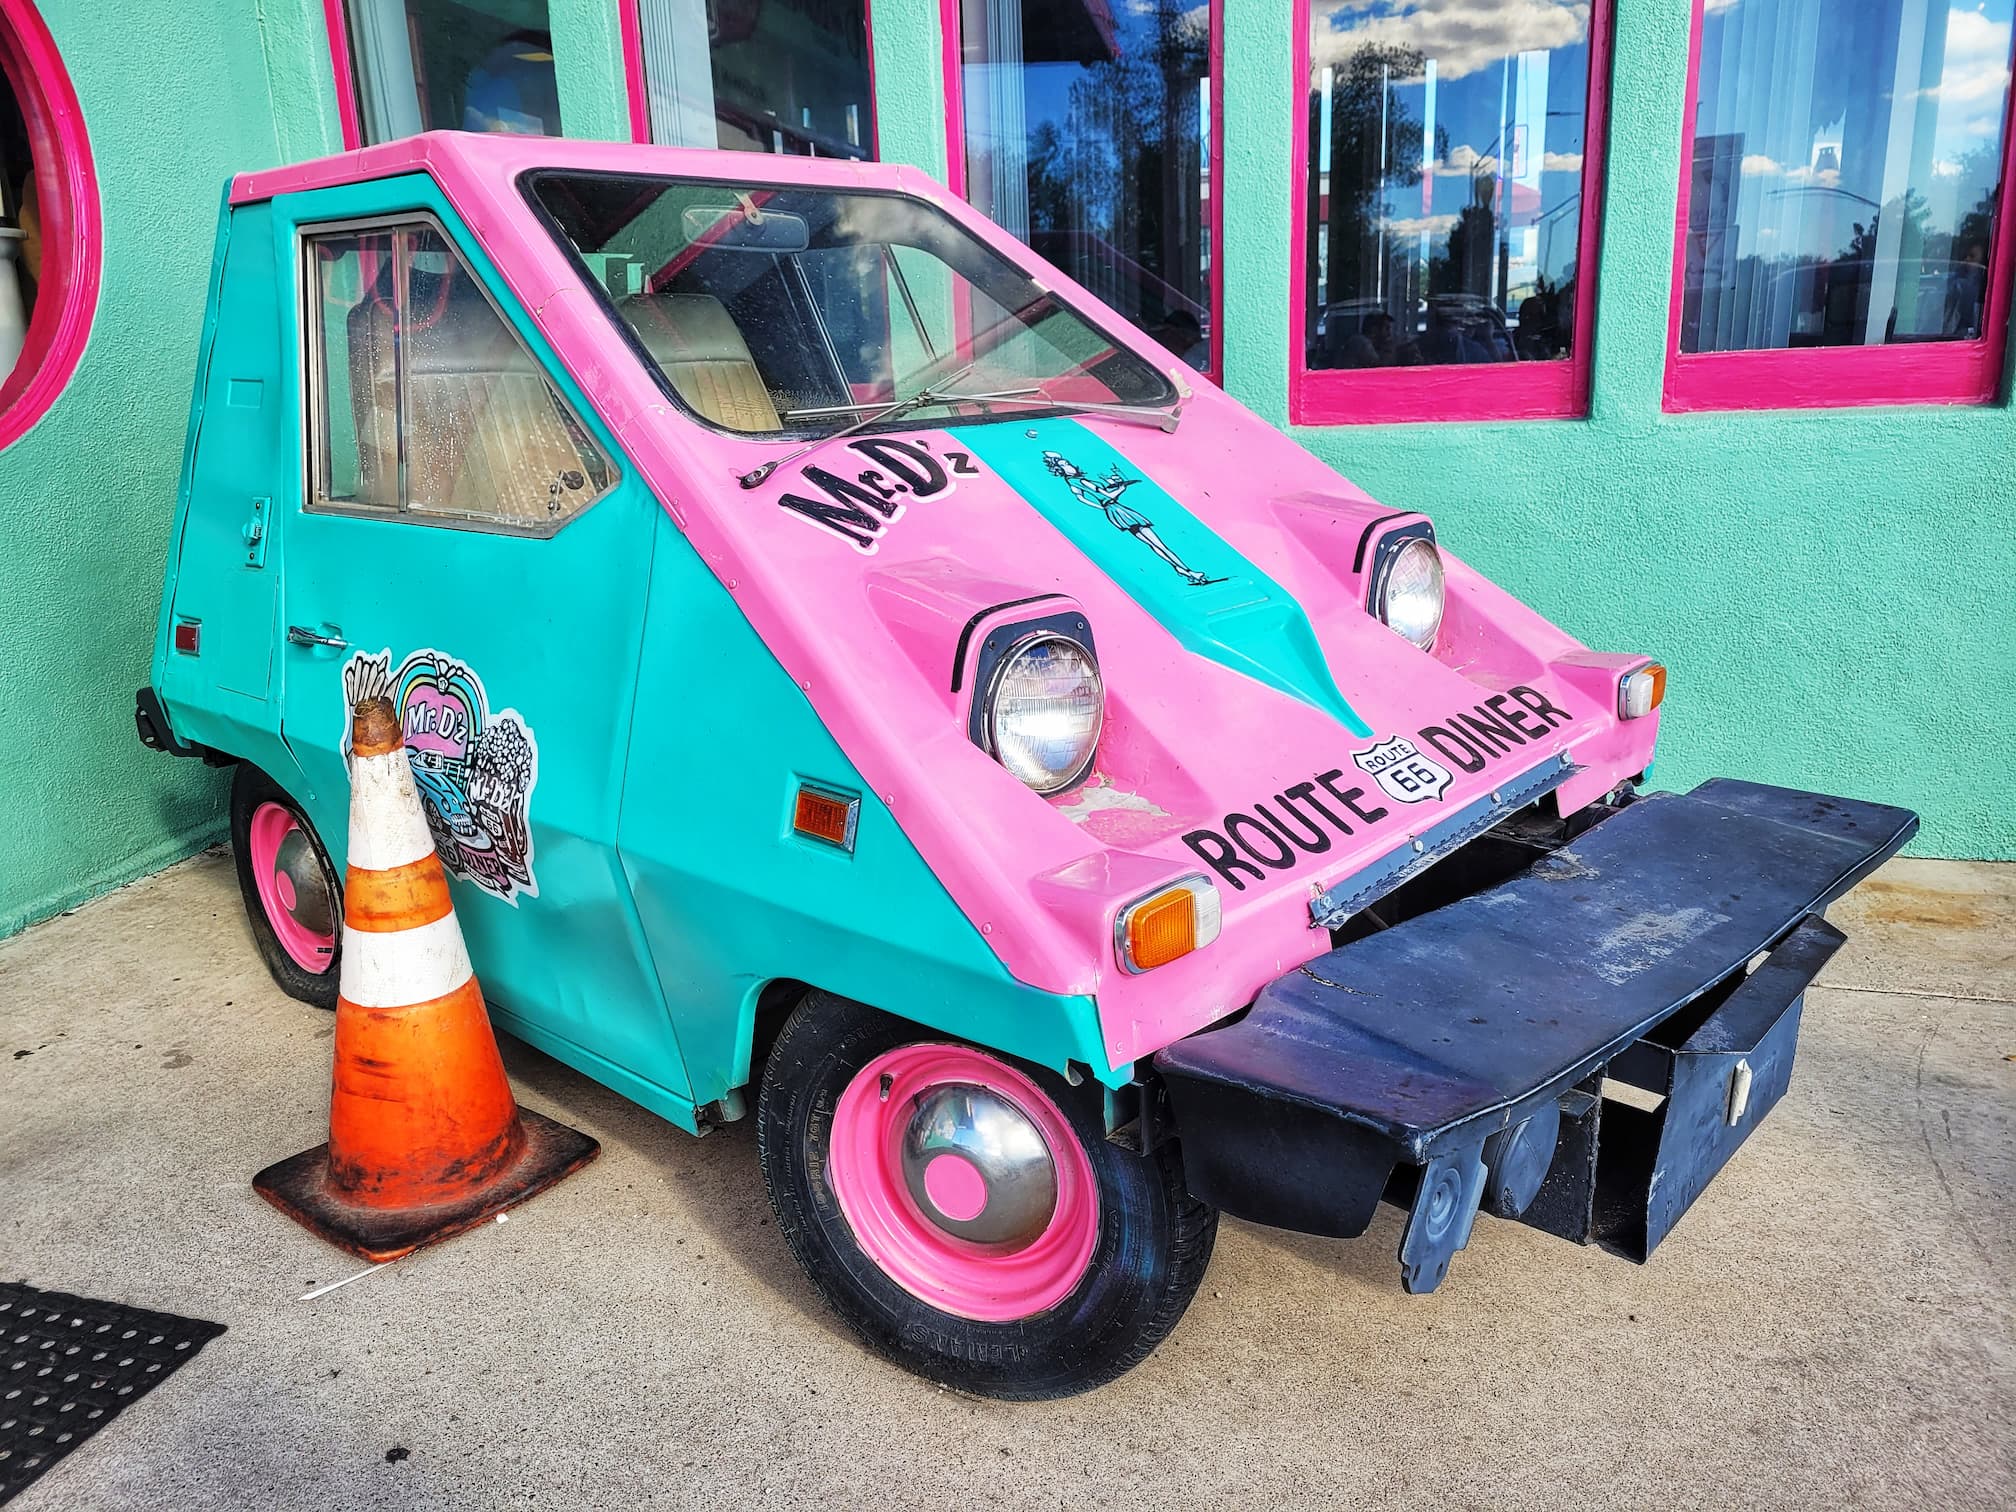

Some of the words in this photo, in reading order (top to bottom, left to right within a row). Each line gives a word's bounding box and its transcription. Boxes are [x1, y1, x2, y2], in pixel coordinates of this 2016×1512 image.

[405, 701, 437, 741] Mr.
[1366, 744, 1411, 770] ROUTE
[1181, 768, 1389, 891] ROUTE
[1390, 762, 1438, 793] 66
[1417, 685, 1573, 774] DINER
